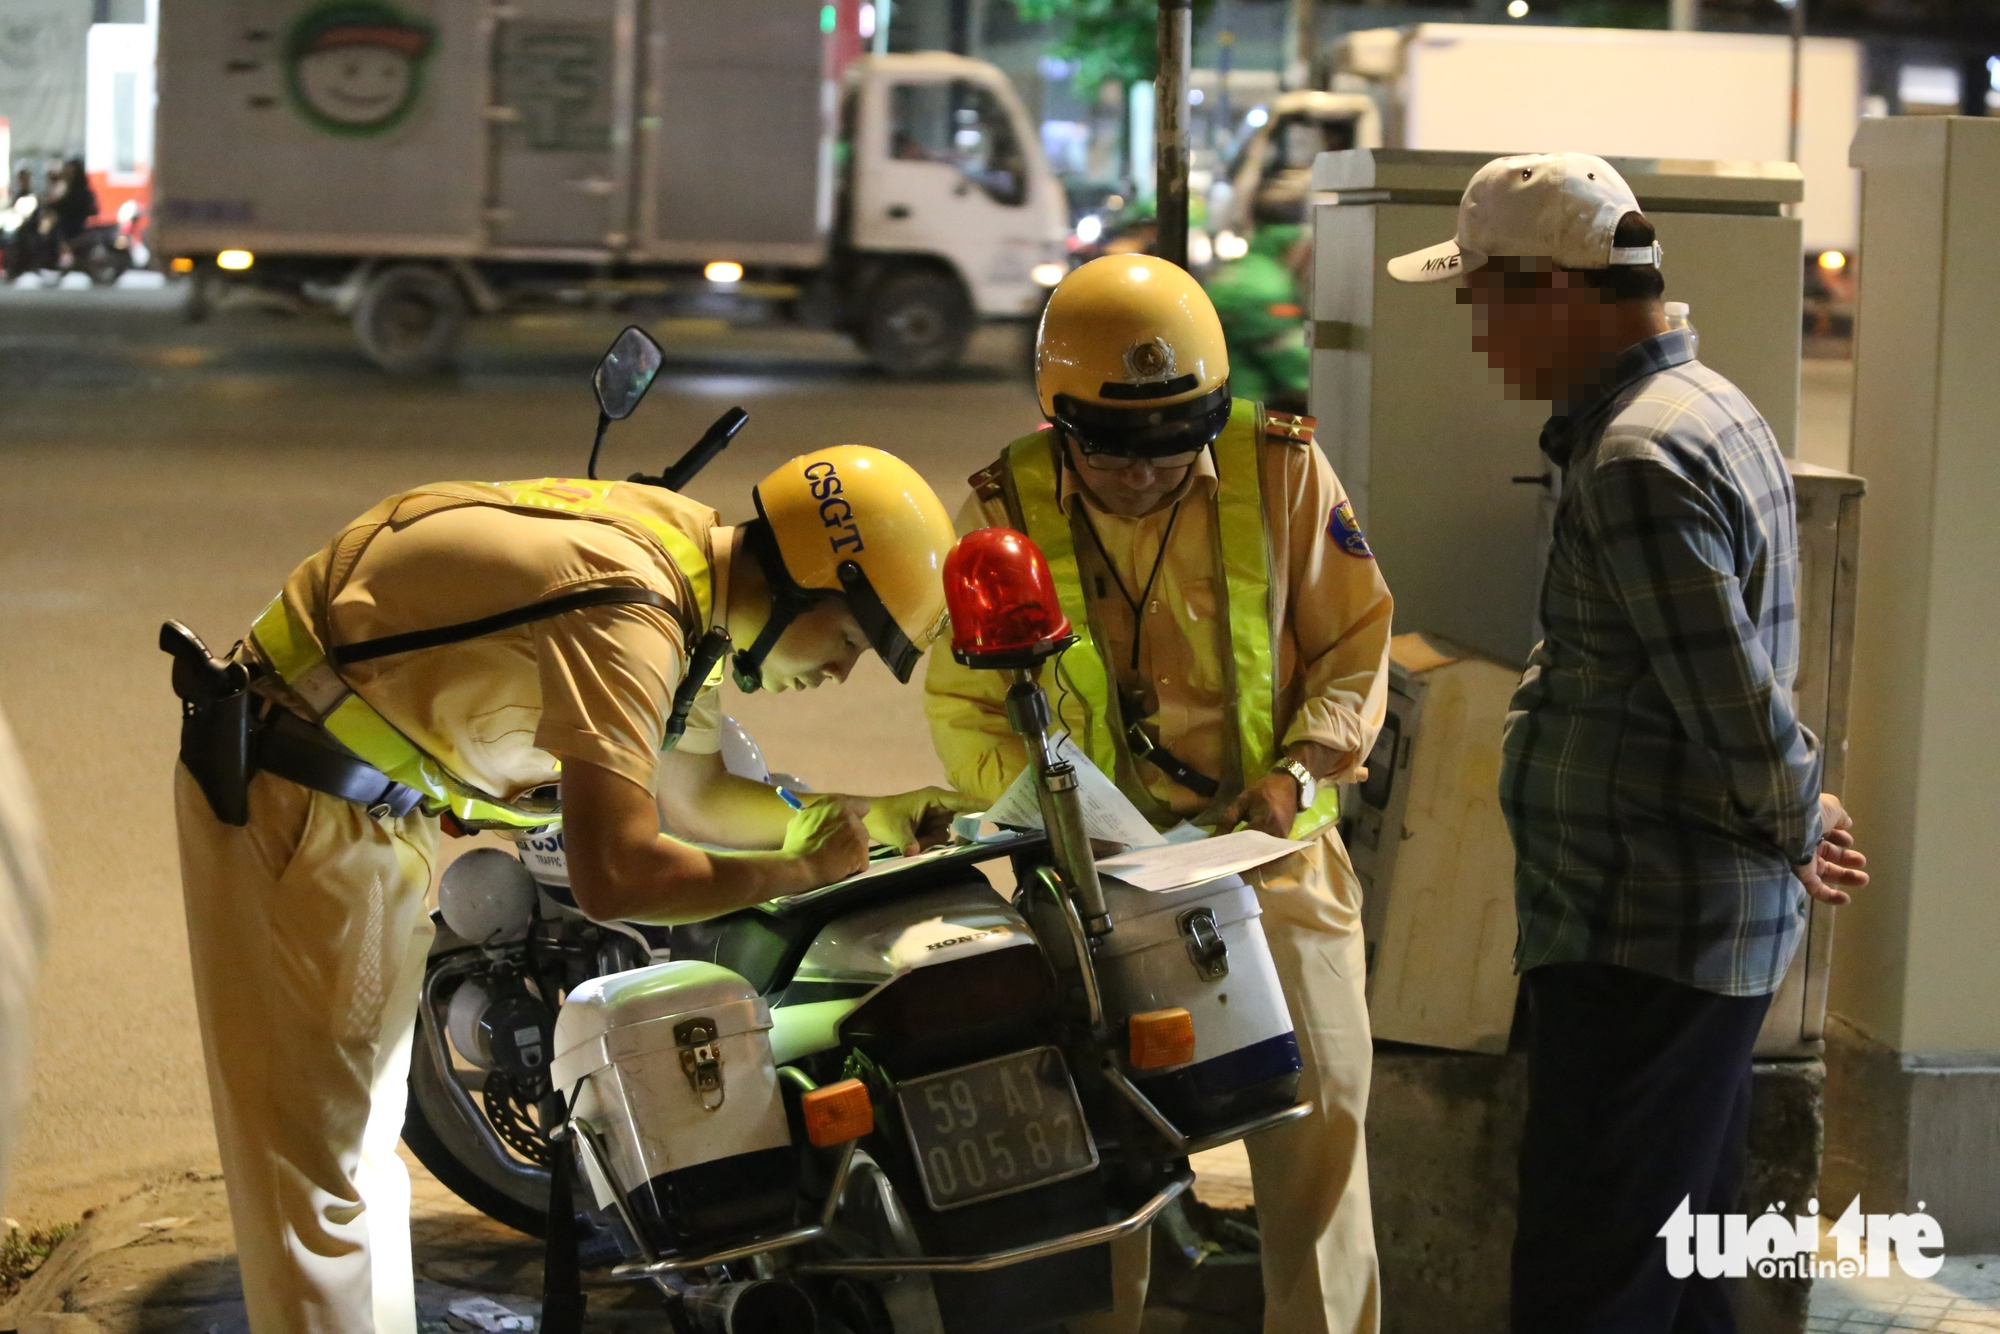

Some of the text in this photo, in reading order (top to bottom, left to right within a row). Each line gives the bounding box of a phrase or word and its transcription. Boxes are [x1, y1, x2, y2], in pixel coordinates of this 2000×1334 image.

[1421, 256, 1459, 272] NIKE
[804, 461, 865, 554] CSGT
[535, 854, 562, 868] TRAFFIC
